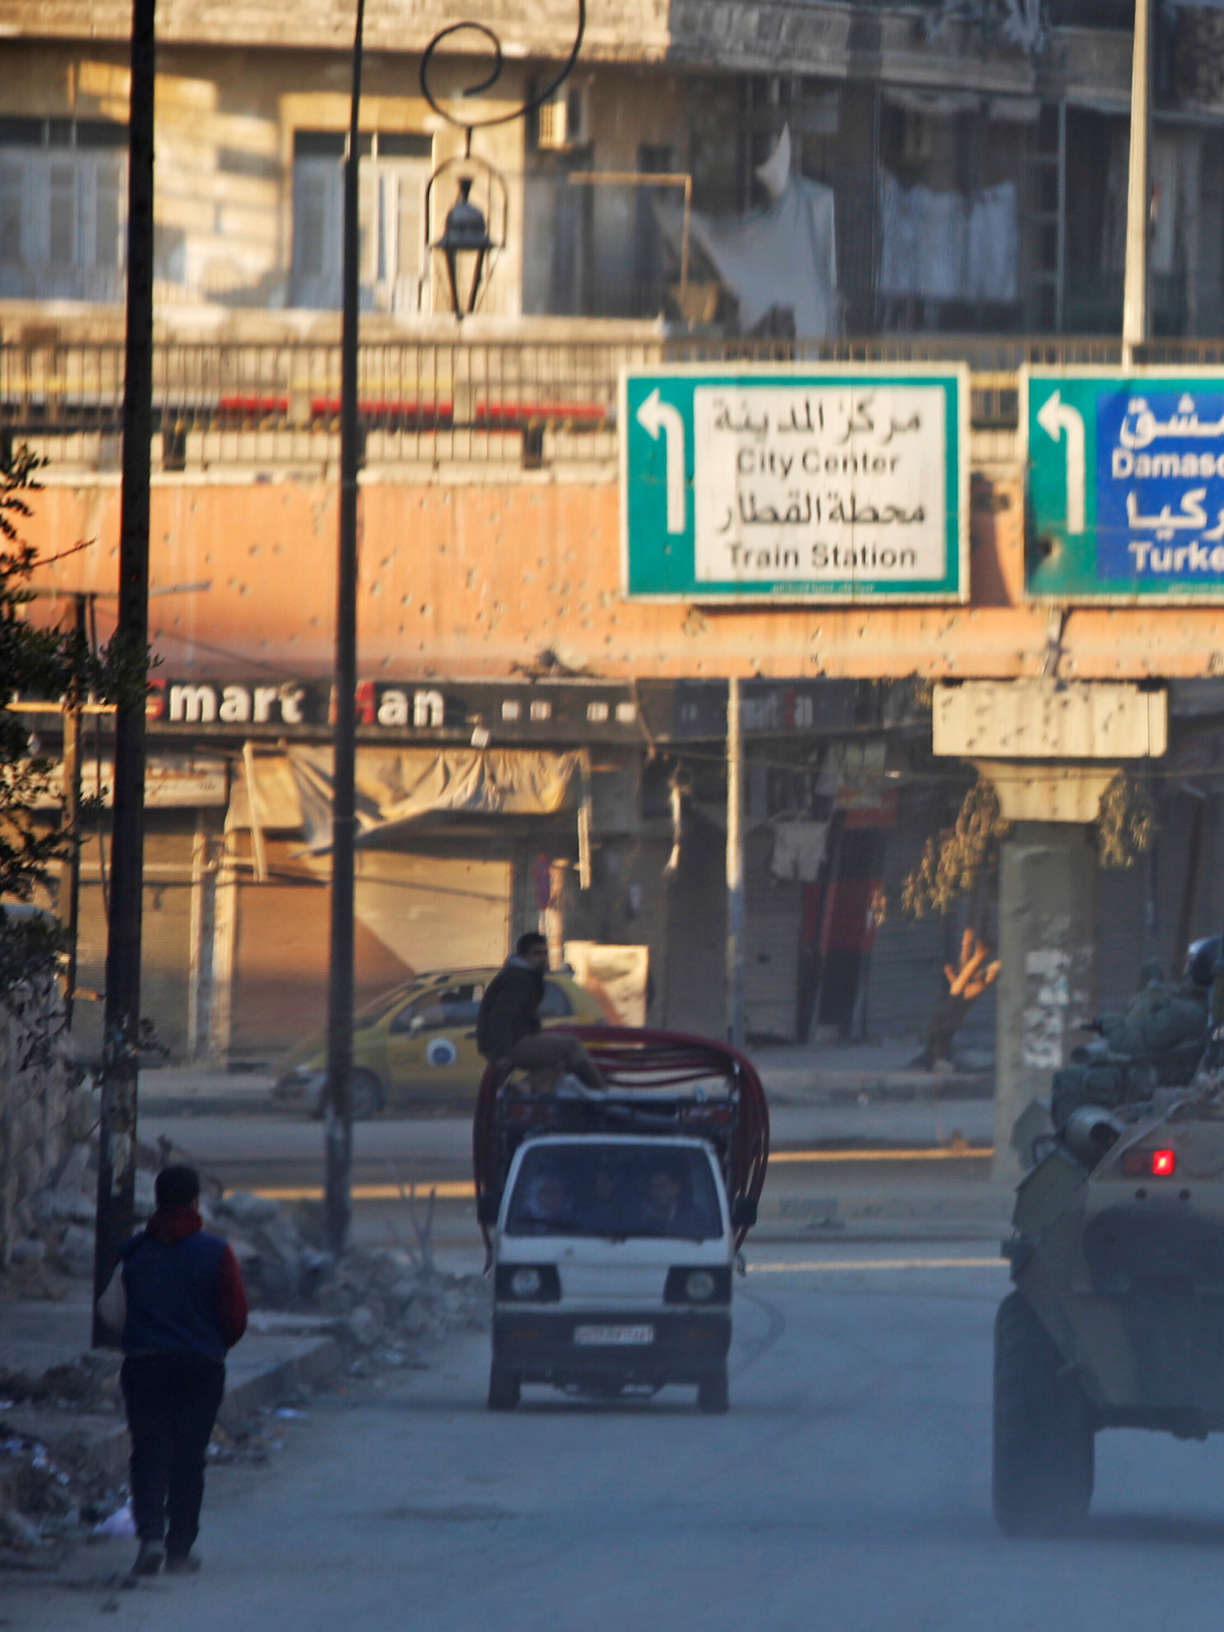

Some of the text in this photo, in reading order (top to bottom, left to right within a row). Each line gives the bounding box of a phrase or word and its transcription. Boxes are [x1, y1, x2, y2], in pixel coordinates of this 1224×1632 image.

[713, 397, 922, 444] مركز المدينة
[736, 449, 902, 479] City Center
[716, 490, 927, 535] محطة القطار
[728, 543, 918, 569] Train Station
